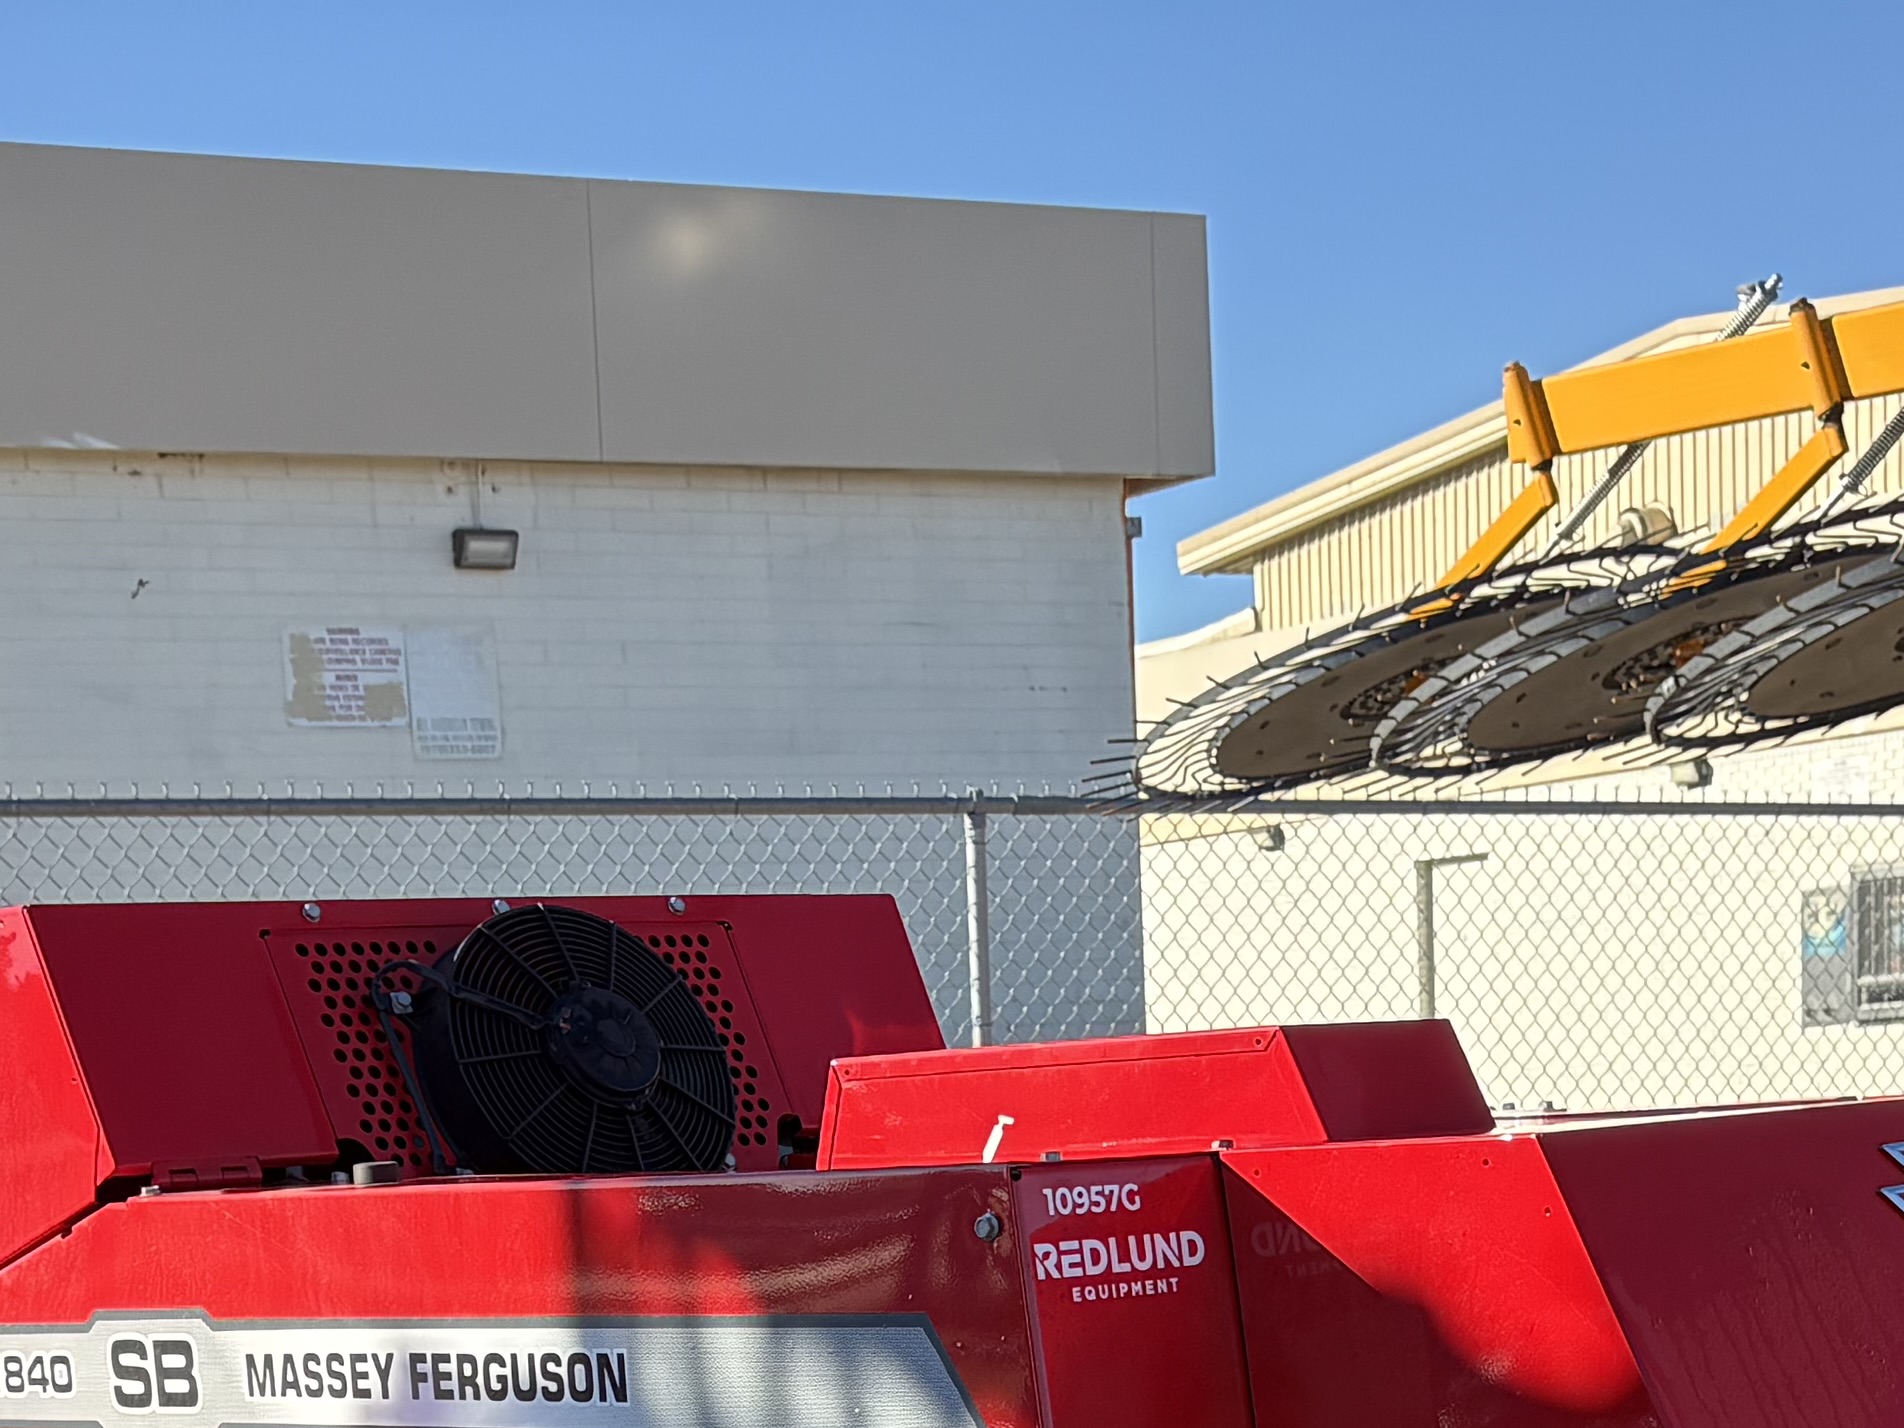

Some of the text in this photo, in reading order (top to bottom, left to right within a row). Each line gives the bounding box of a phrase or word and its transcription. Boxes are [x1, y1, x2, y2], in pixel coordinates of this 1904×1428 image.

[1042, 1183, 1141, 1216] 10957G
[1033, 1231, 1205, 1280] REDLUND
[1072, 1277, 1179, 1302] EQUIPMENT
[110, 1338, 199, 1408] SB
[245, 1352, 394, 1399] MASSEY
[408, 1352, 629, 1404] FERGUSON
